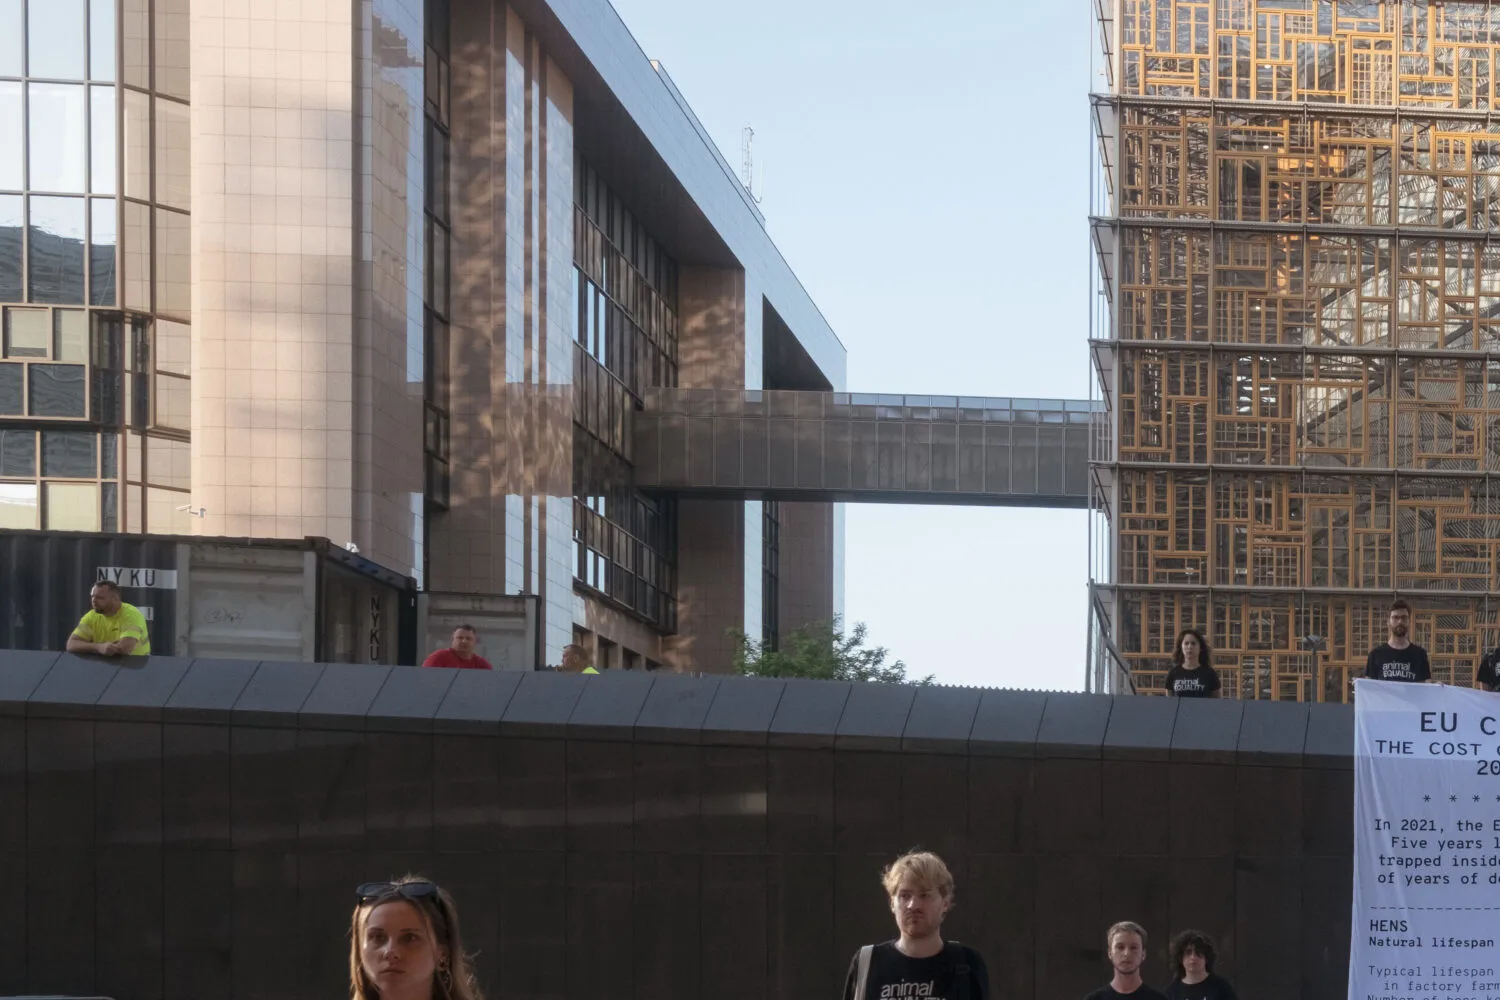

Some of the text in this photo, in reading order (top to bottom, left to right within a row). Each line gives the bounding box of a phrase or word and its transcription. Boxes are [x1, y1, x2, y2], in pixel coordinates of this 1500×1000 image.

[98, 568, 155, 586] NYKU
[371, 597, 380, 661] NYKU
[1382, 662, 1410, 671] animal
[1383, 670, 1416, 680] EQUALITY
[1420, 711, 1458, 733] EU
[1375, 739, 1414, 755] THE
[1428, 741, 1482, 756] COST
[1374, 818, 1391, 831] In
[1400, 818, 1444, 834] 2021,
[1456, 819, 1483, 832] the
[1391, 836, 1428, 849] Five
[1437, 839, 1483, 852] years
[1379, 855, 1442, 871] trapped
[1377, 871, 1395, 884] of
[1405, 874, 1450, 887] years
[1460, 872, 1479, 885] of
[1369, 919, 1408, 933] HENS
[1368, 936, 1423, 948] Natural
[1431, 937, 1494, 950] lifespan
[1367, 965, 1494, 978] Typical lifespan
[881, 979, 933, 997] animal
[1384, 979, 1402, 992] in
[1407, 980, 1462, 993] factory
